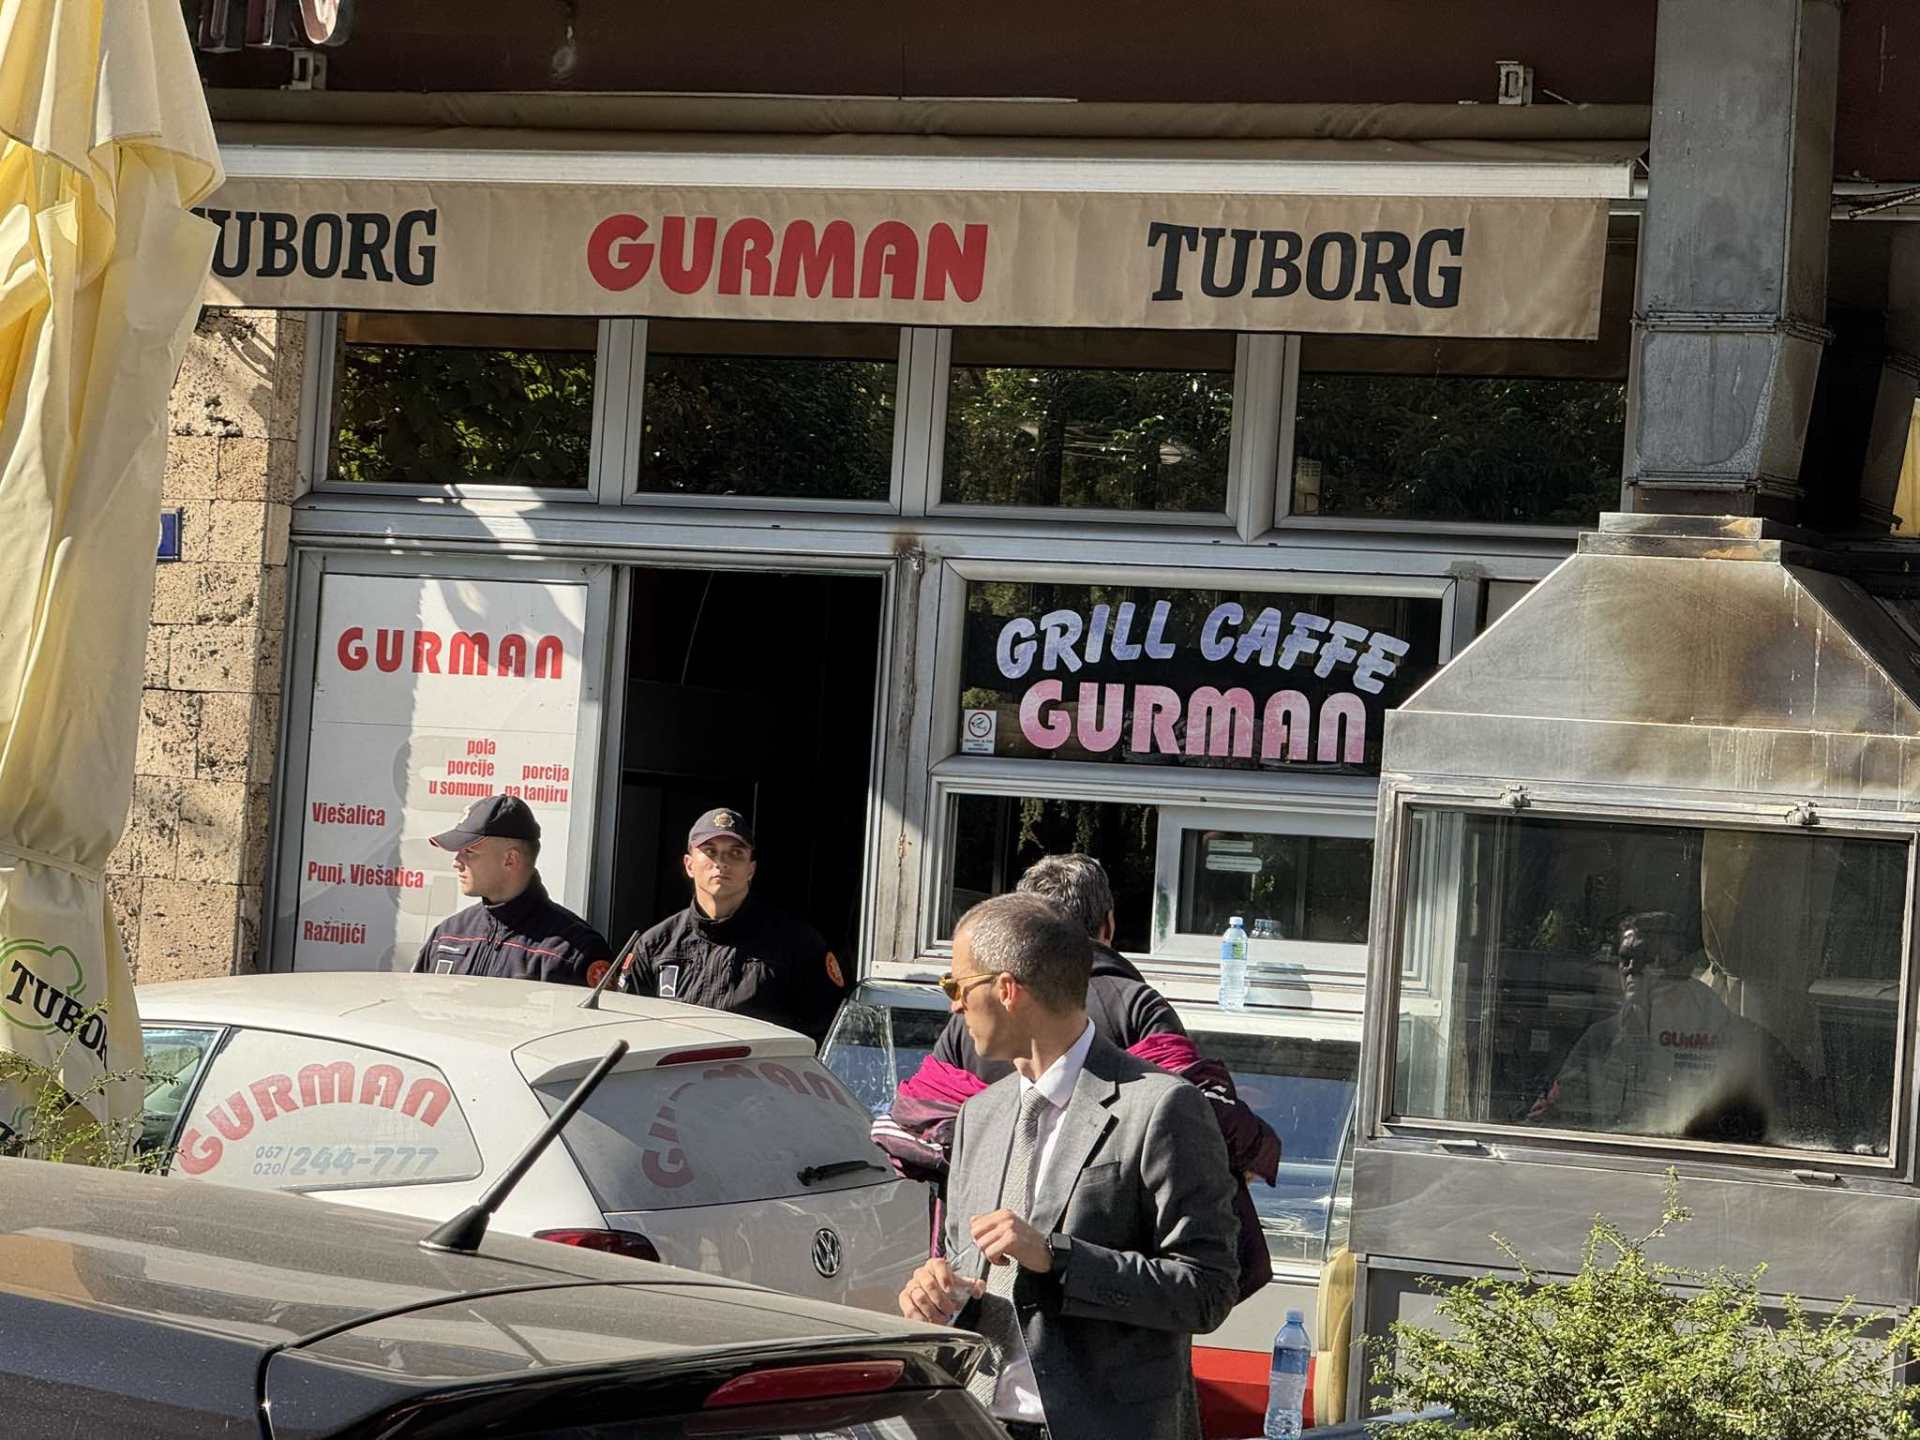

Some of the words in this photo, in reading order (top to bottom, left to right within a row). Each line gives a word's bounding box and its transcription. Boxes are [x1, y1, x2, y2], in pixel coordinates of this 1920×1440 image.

[190, 208, 437, 286] UBORG
[587, 213, 989, 303] GURMAN
[1147, 222, 1465, 309] TUBORG
[337, 627, 564, 680] GURMAN
[996, 600, 1176, 680] GRILL
[1200, 602, 1410, 694] CAFFE
[1018, 679, 1367, 764] GURMAN
[467, 738, 496, 756] pola
[447, 759, 495, 778] porcije
[522, 764, 570, 783] porcija
[429, 781, 437, 794] u
[440, 781, 493, 797] somunu
[523, 784, 568, 803] tanjiru
[312, 802, 386, 826] Vješalica
[308, 861, 346, 886] Punj.
[350, 863, 424, 889] Vješalica
[303, 919, 366, 945] Ražnjići
[6, 960, 108, 1071] TUBO
[177, 1061, 452, 1176] GURMAN
